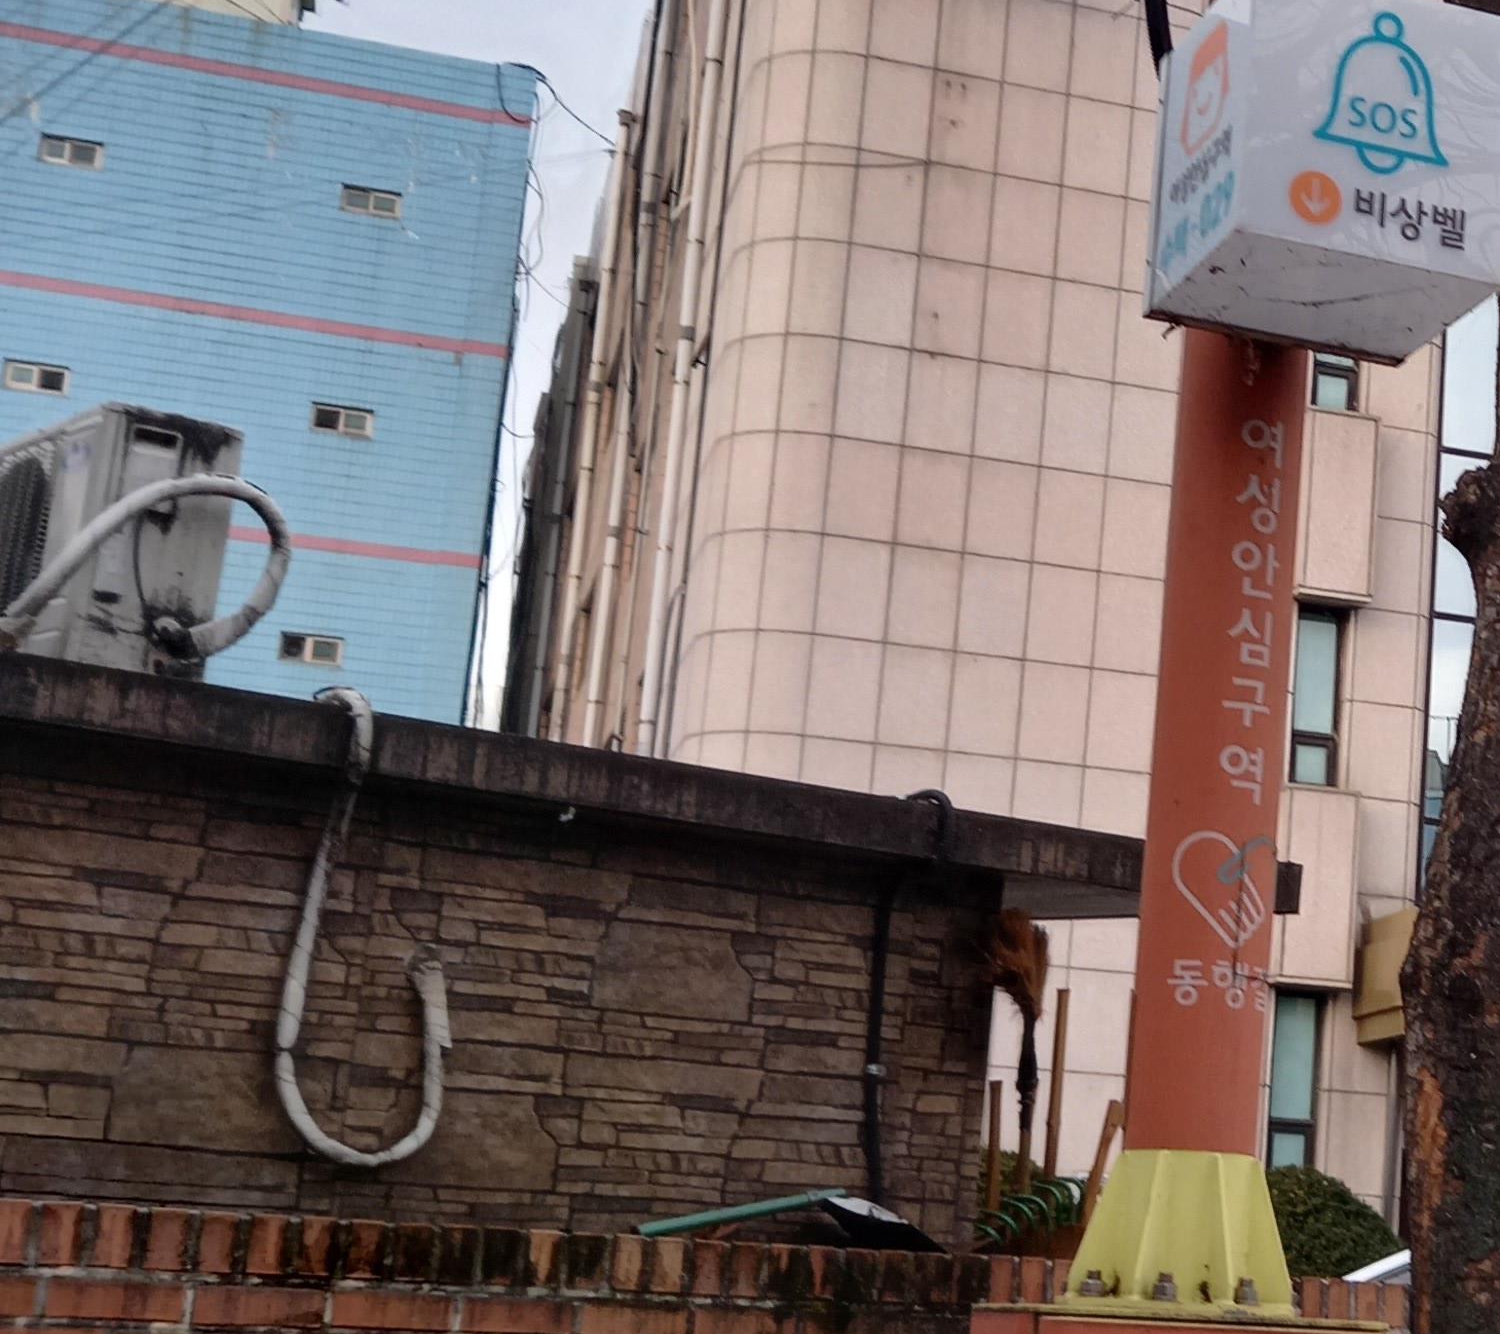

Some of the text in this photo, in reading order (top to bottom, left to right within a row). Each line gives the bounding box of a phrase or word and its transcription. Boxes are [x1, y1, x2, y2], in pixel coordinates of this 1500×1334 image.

[1348, 97, 1418, 139] SOS
[1354, 188, 1466, 252] 비상벨
[1218, 418, 1285, 807] 여성안심구역
